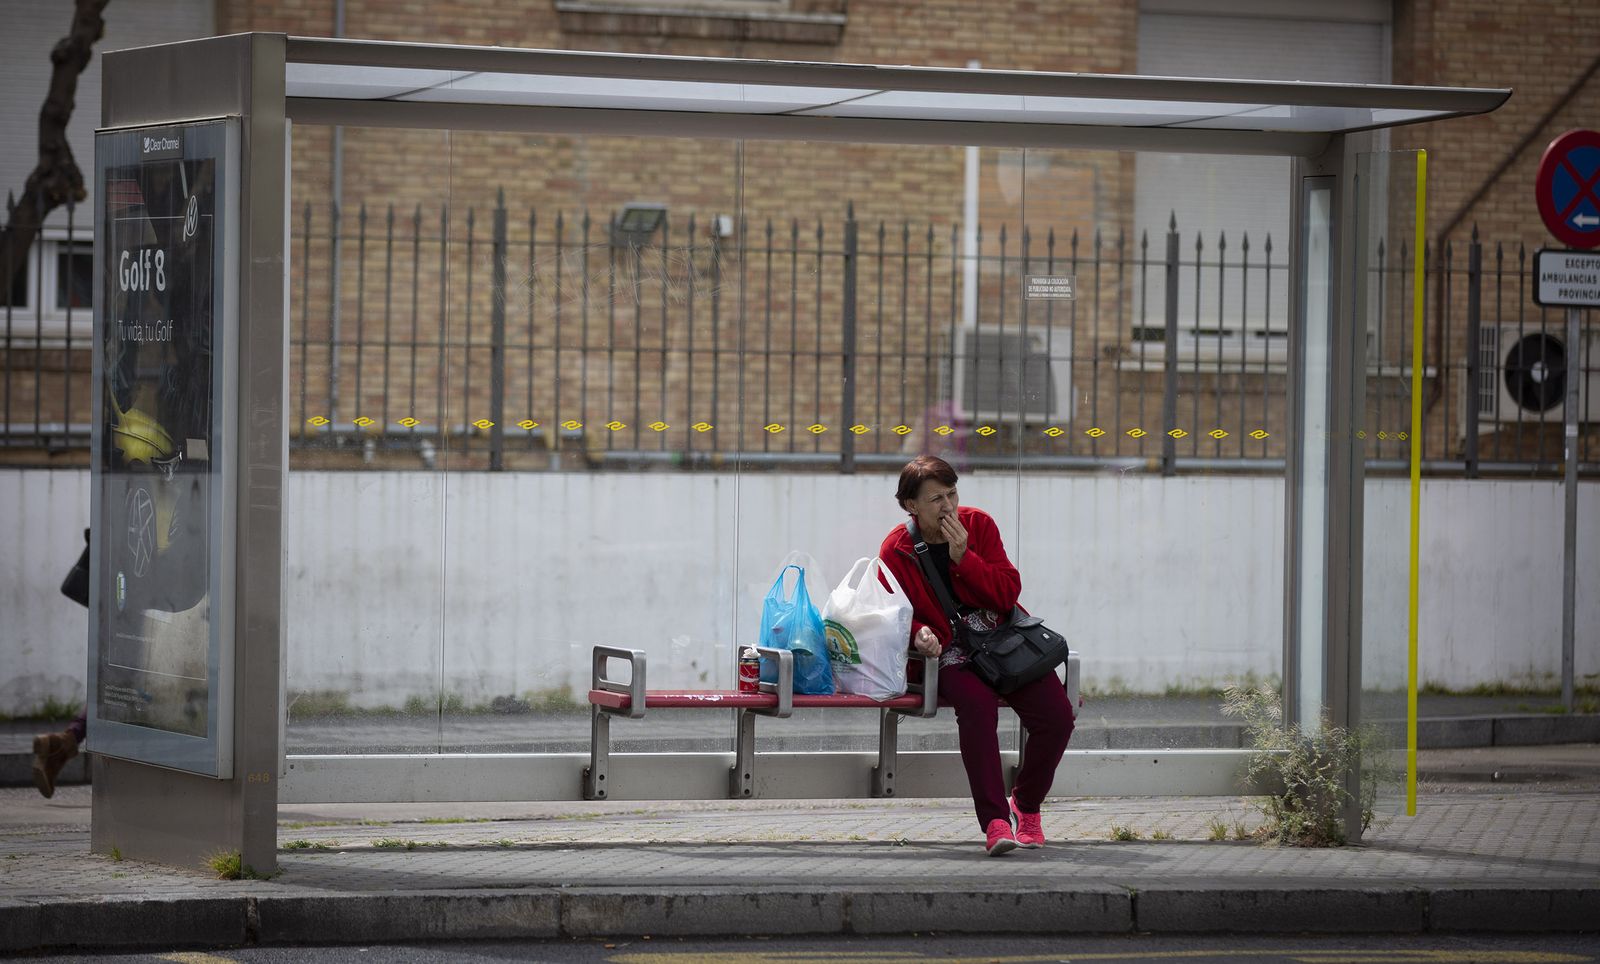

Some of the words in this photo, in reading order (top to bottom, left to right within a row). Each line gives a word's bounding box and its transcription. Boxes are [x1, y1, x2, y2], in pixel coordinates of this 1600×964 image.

[150, 138, 161, 151] Clear
[162, 137, 180, 151] Channel
[119, 249, 151, 291] Golf
[154, 249, 166, 291] 8
[1565, 258, 1600, 270] EXCEPTO
[1542, 271, 1597, 285] AMBULANCIAS
[118, 320, 126, 341] Tu
[127, 319, 144, 345] vida,
[145, 323, 154, 341] tu
[155, 319, 174, 341] Golf
